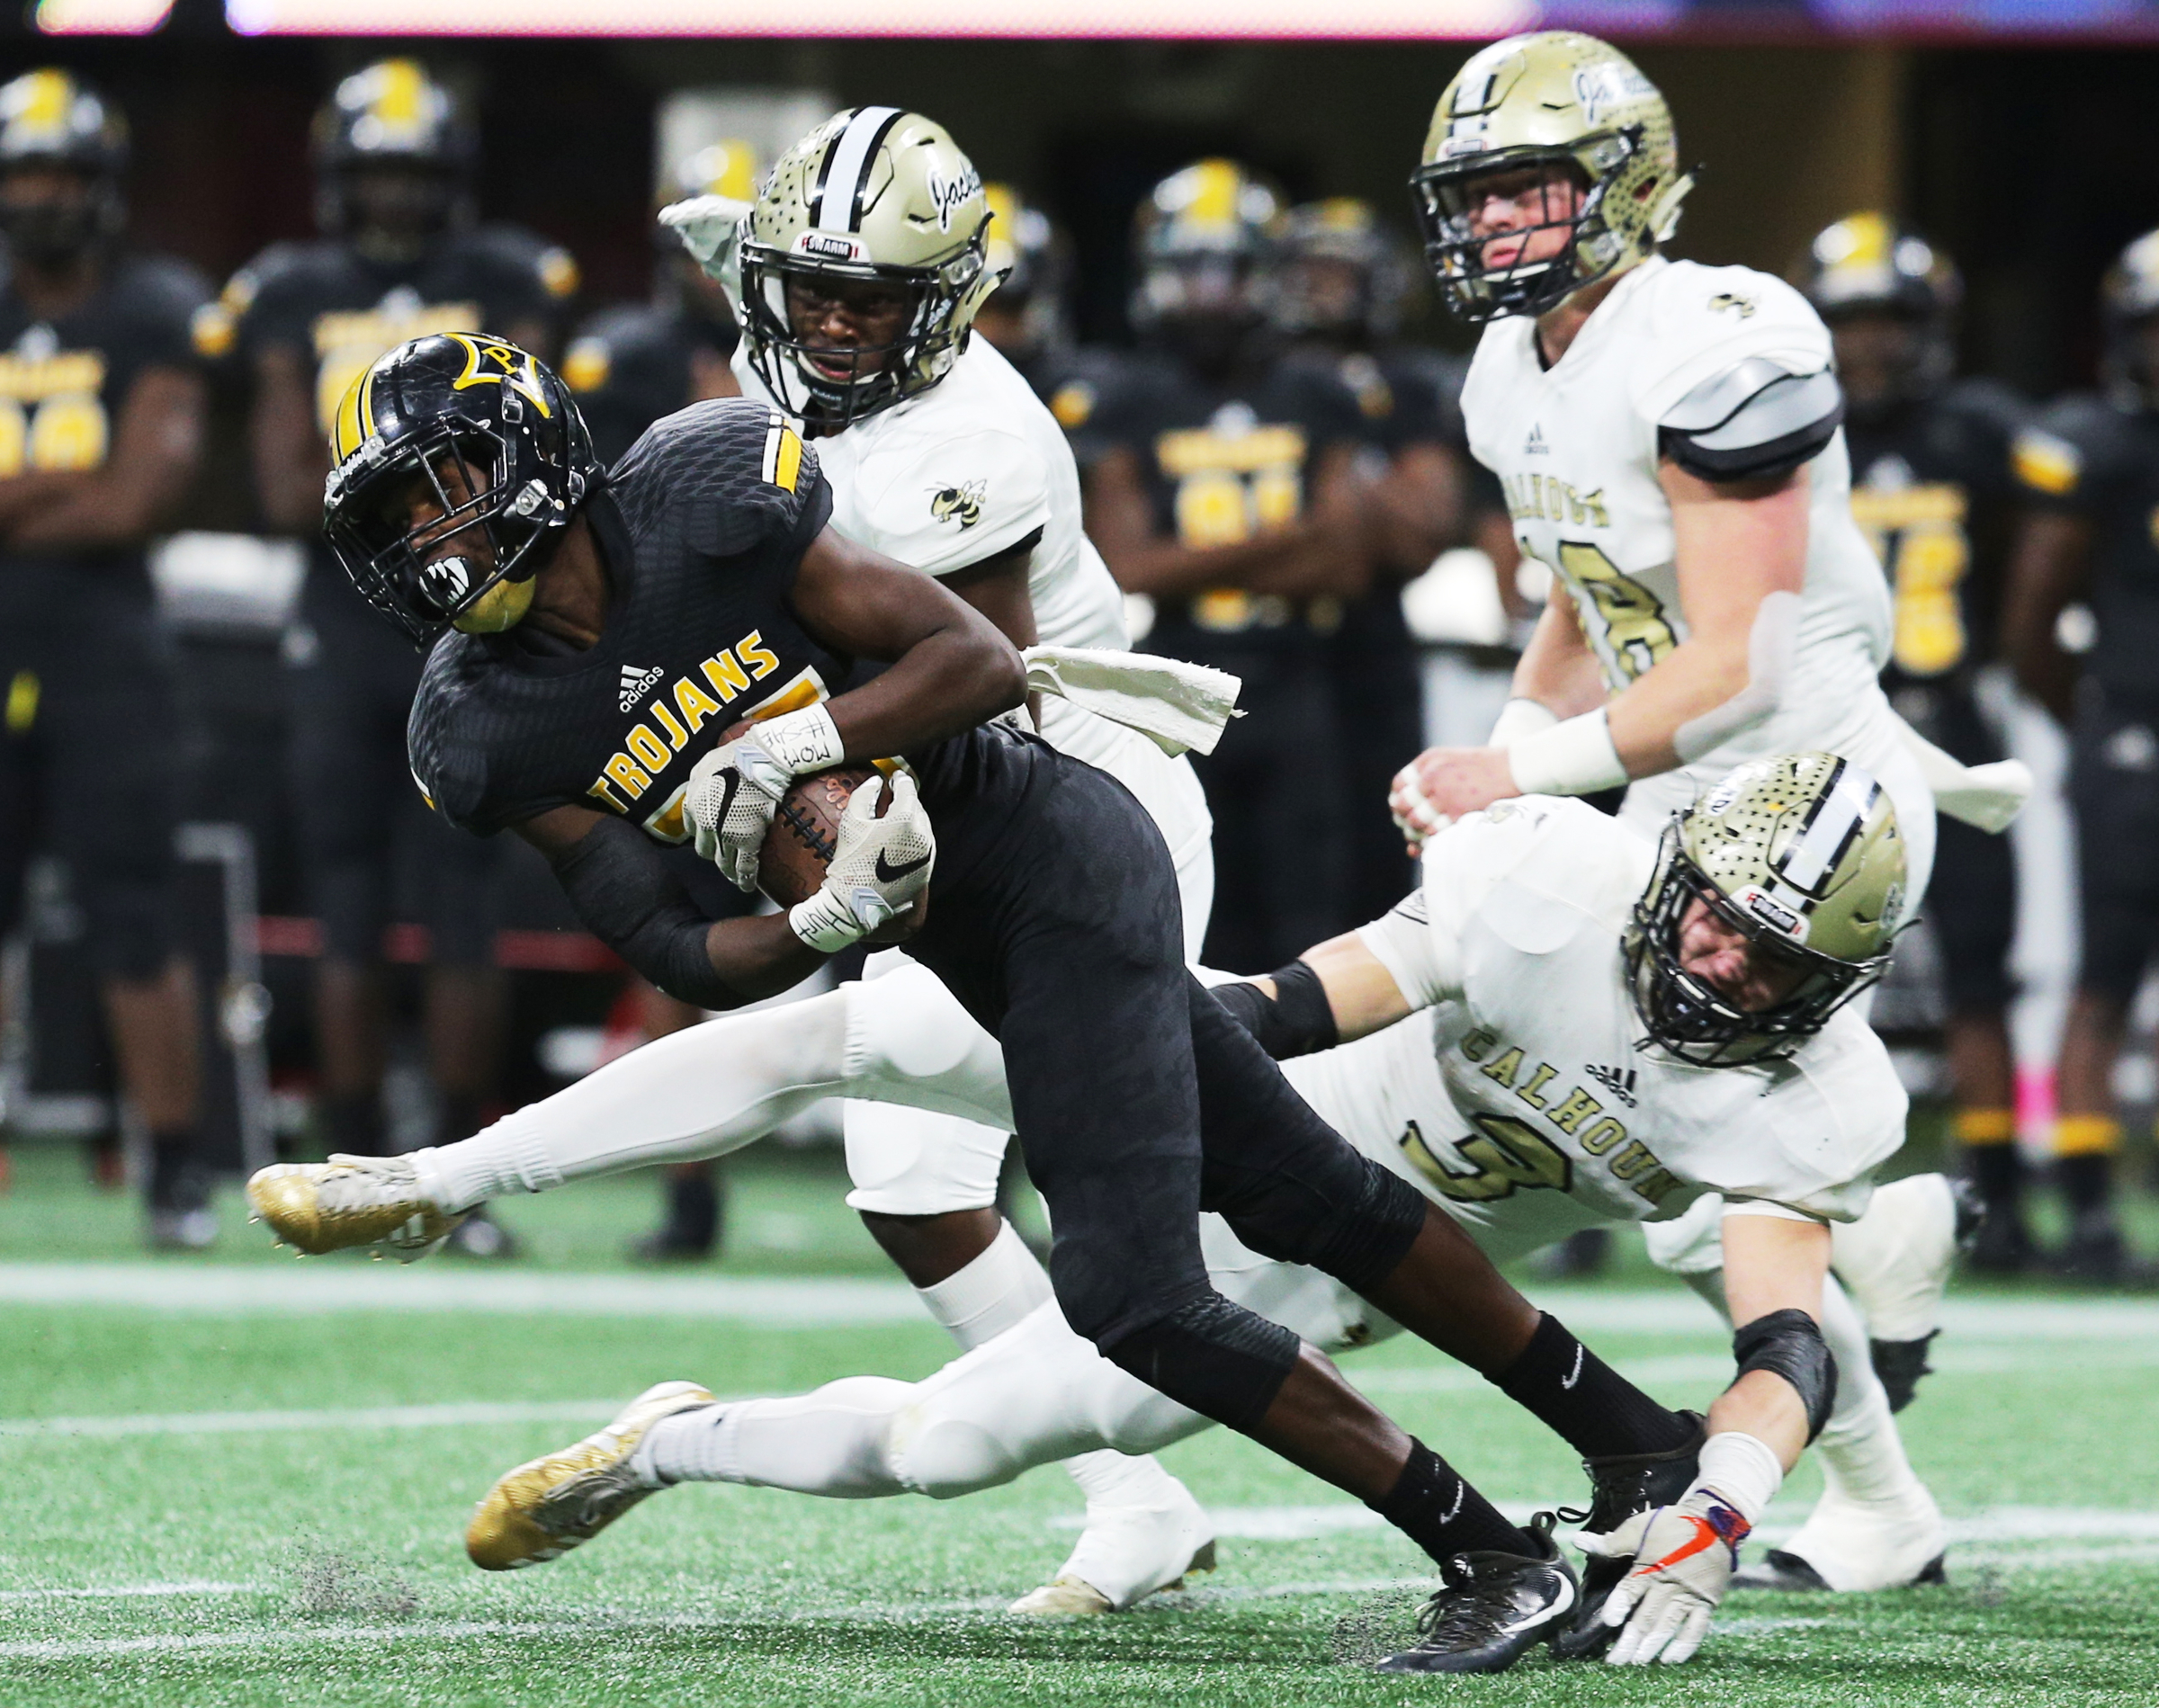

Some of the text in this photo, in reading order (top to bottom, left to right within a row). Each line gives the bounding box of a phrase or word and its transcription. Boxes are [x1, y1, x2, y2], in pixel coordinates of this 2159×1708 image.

[808, 236, 850, 257] SWARM
[481, 346, 519, 375] P
[619, 666, 664, 713] adidas
[587, 629, 780, 814] TROJANS
[782, 741, 831, 768] MOM
[795, 901, 857, 943] Hurt
[1584, 1063, 1638, 1108] adidas
[1459, 1027, 1688, 1205] CALHOUN
